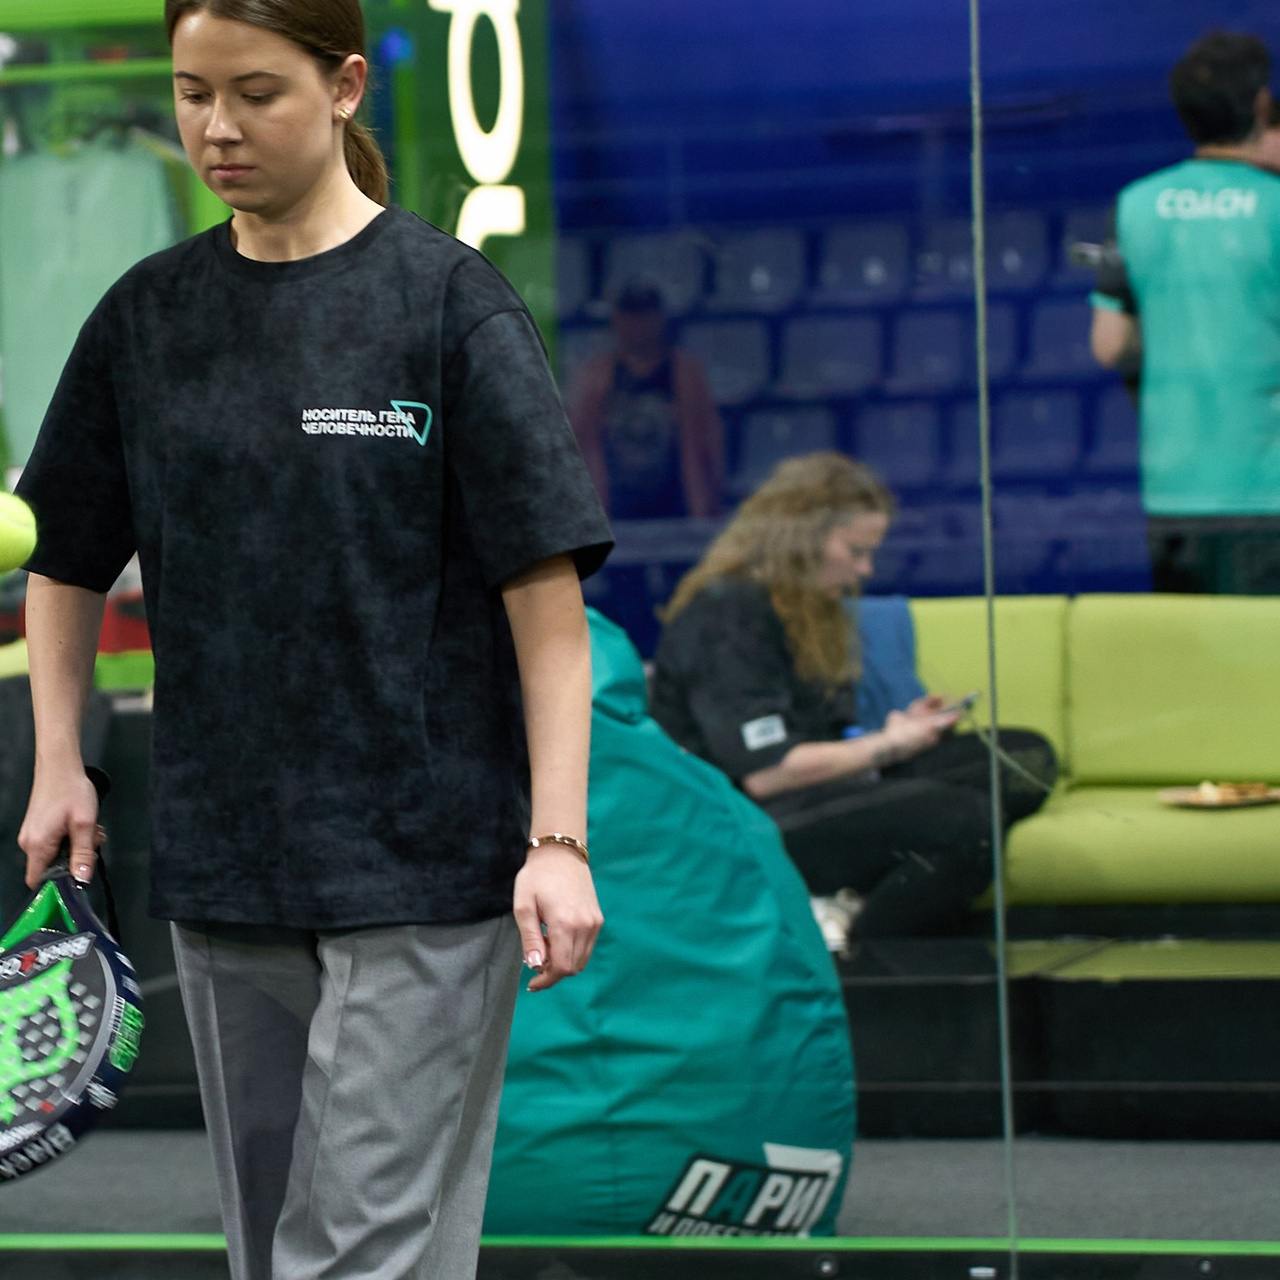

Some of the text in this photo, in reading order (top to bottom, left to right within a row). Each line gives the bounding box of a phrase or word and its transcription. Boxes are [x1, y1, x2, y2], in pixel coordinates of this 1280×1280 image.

[302, 409, 416, 425] НОСИТЕЛЬ ГЕНА
[301, 422, 414, 438] ЧЕЛОВЕЧНОСТИ
[667, 1158, 824, 1229] ПАРИ
